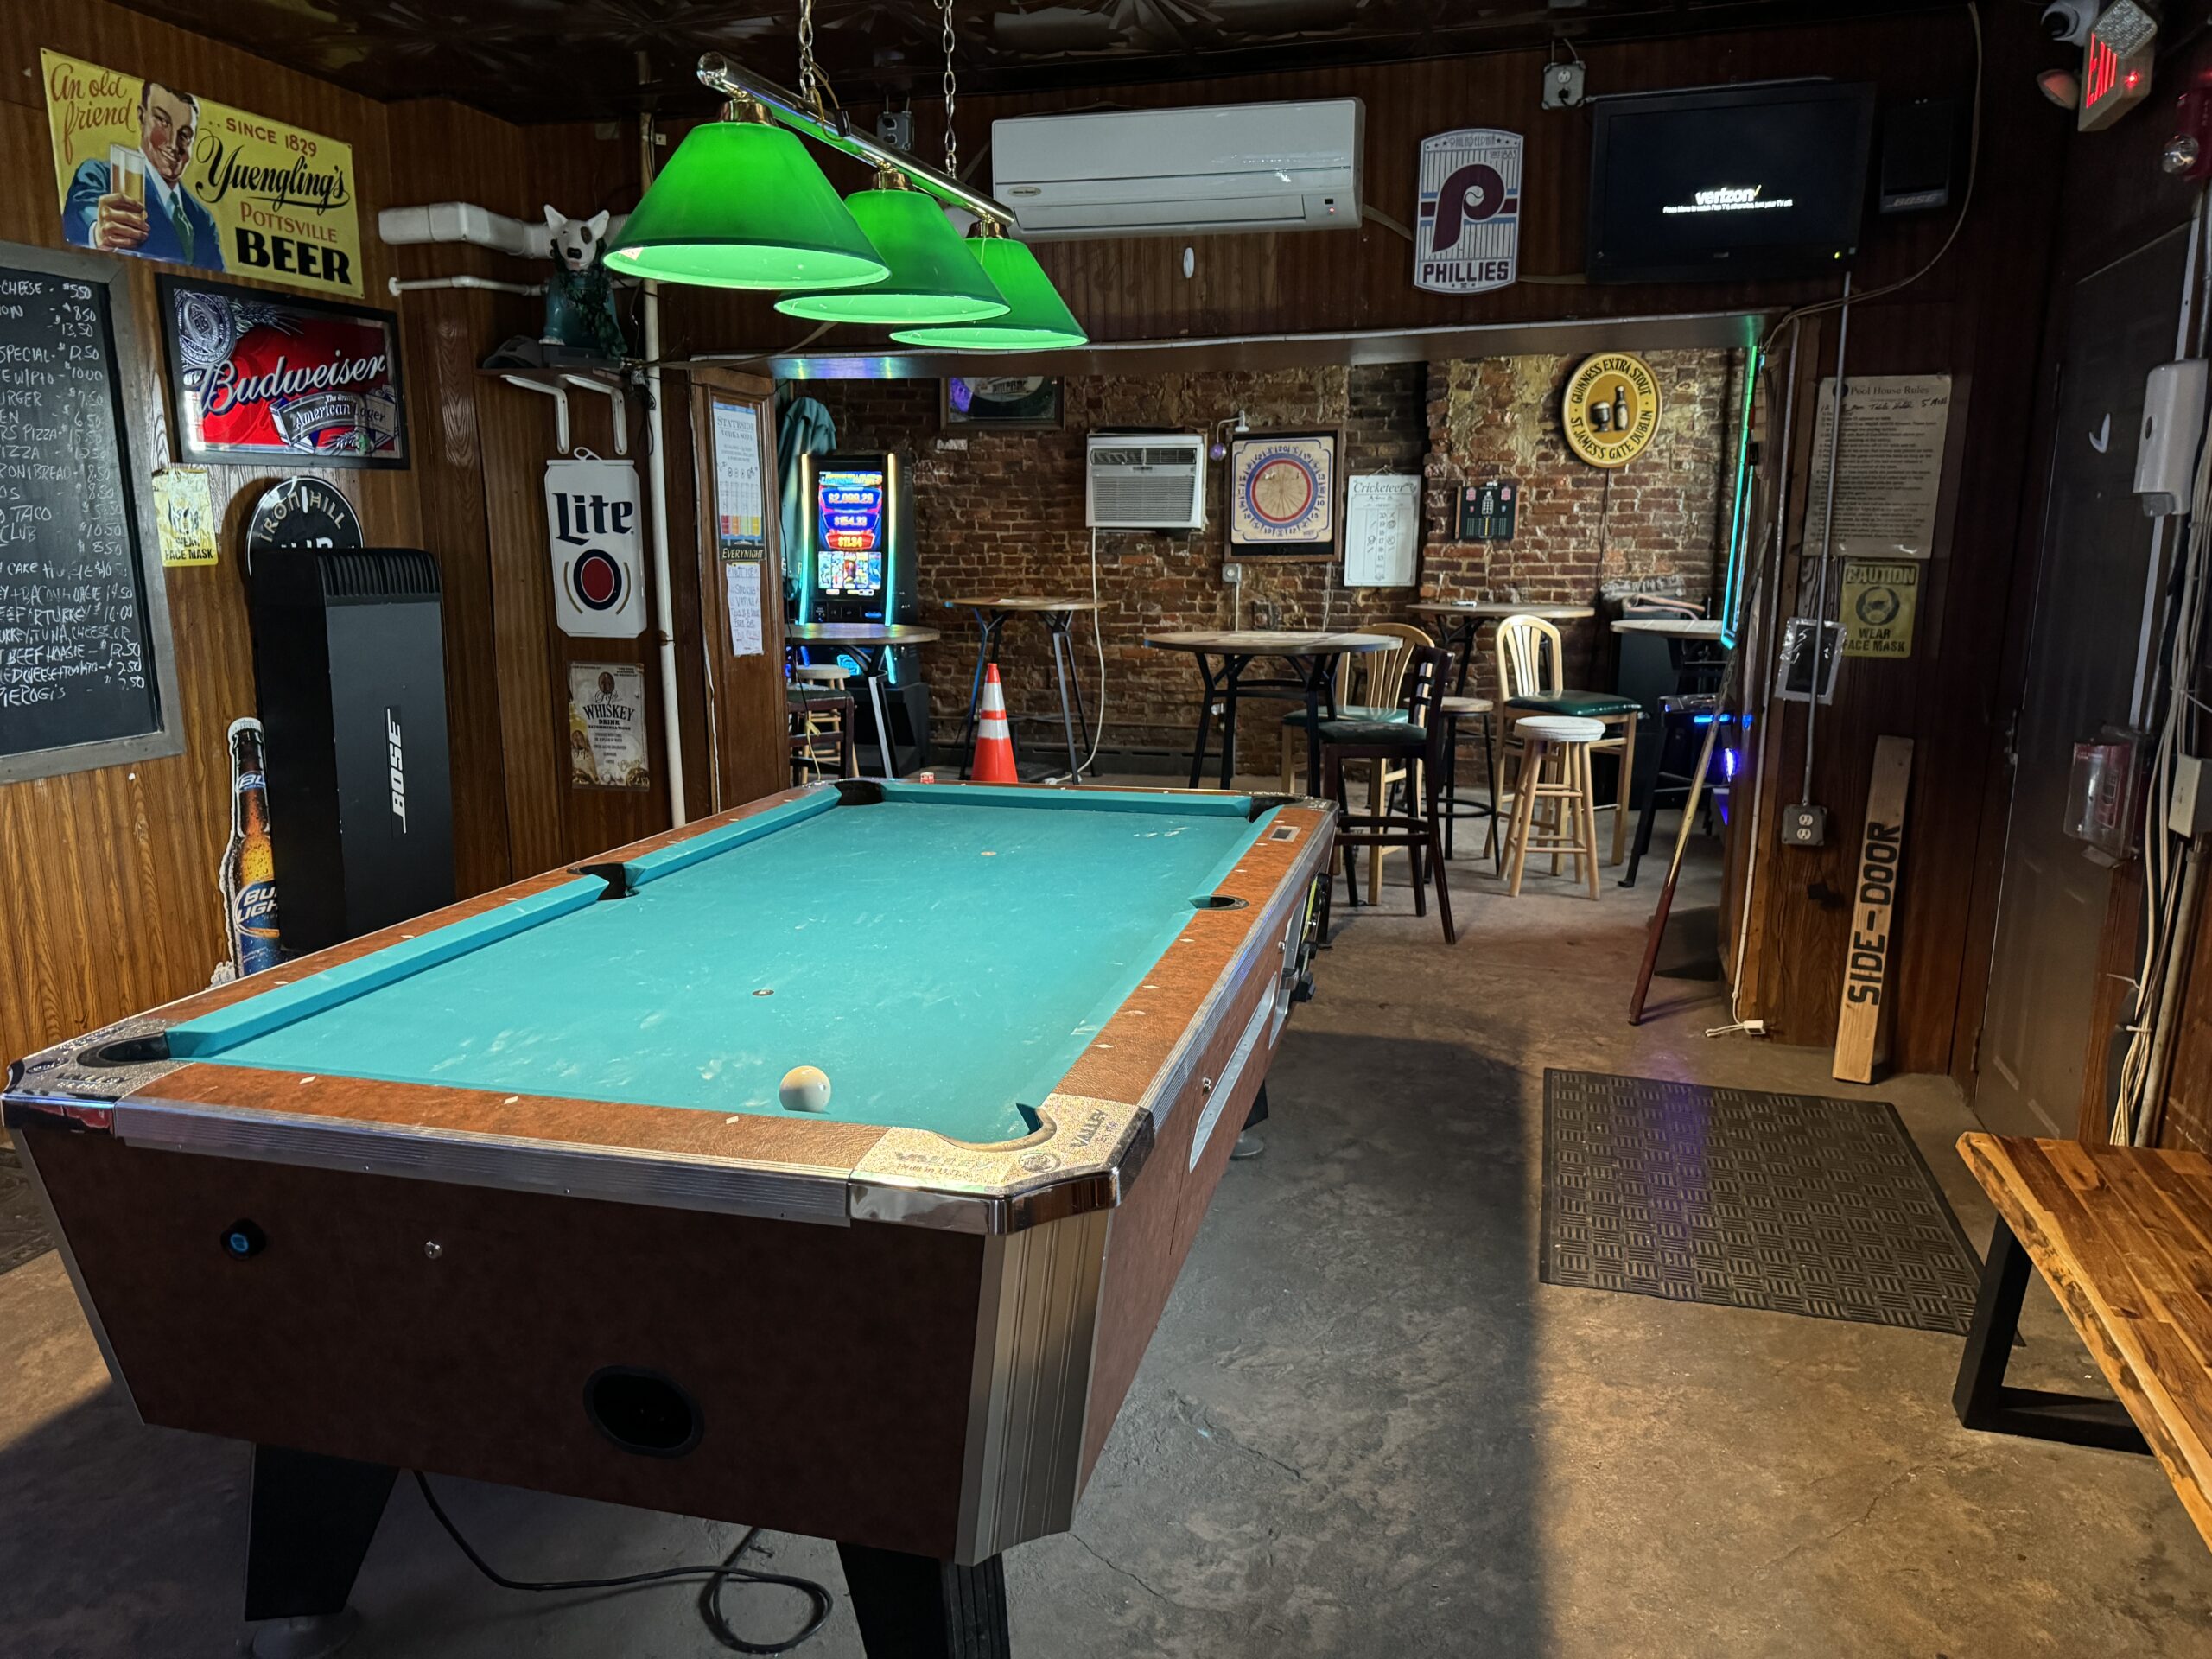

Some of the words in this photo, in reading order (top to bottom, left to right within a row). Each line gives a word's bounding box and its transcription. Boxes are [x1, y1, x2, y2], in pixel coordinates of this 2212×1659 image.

[50, 63, 83, 102] An
[88, 71, 128, 99] old
[63, 97, 137, 166] friend
[226, 117, 277, 145] SINCE
[284, 133, 318, 157] 1829
[195, 128, 350, 216] Yuengling's
[1695, 187, 1755, 206] verizon
[240, 201, 338, 244] POTTSVILLE
[234, 226, 353, 286] BEER
[1422, 261, 1510, 284] PHILLIES
[200, 349, 387, 417] Budweiser
[1571, 364, 1603, 404] GUINNESS
[1602, 358, 1630, 375] EXTRA
[1630, 367, 1652, 397] STOUT
[1851, 385, 1871, 396] Pool
[1873, 385, 1902, 395] House
[1904, 385, 1929, 395] Rules
[295, 401, 351, 430] American
[353, 404, 386, 423] Lager
[716, 416, 755, 431] STATESIDE
[22, 423, 57, 442] PIZZA
[1609, 442, 1634, 460] GATE
[1630, 410, 1653, 445] DUBLIN
[0, 445, 40, 461] IZZA
[1353, 481, 1404, 493] Cricketeer
[10, 505, 52, 523] TACO
[309, 490, 346, 530] HILL
[552, 493, 633, 546] Lite
[0, 522, 36, 543] CLUB
[165, 548, 187, 561] FACE
[188, 548, 213, 560] MASK
[721, 546, 764, 560] EVERYNIGHT
[1846, 566, 1916, 585] CAUTION
[1859, 627, 1891, 639] WEAR
[6, 645, 44, 664] BEEF
[1843, 639, 1871, 651] FACE
[1873, 639, 1905, 652] MASK
[582, 703, 635, 721] WHISKEY
[387, 708, 407, 835] BOSE
[244, 887, 276, 906] BU
[1847, 821, 1900, 1006] SIDE-DOOR
